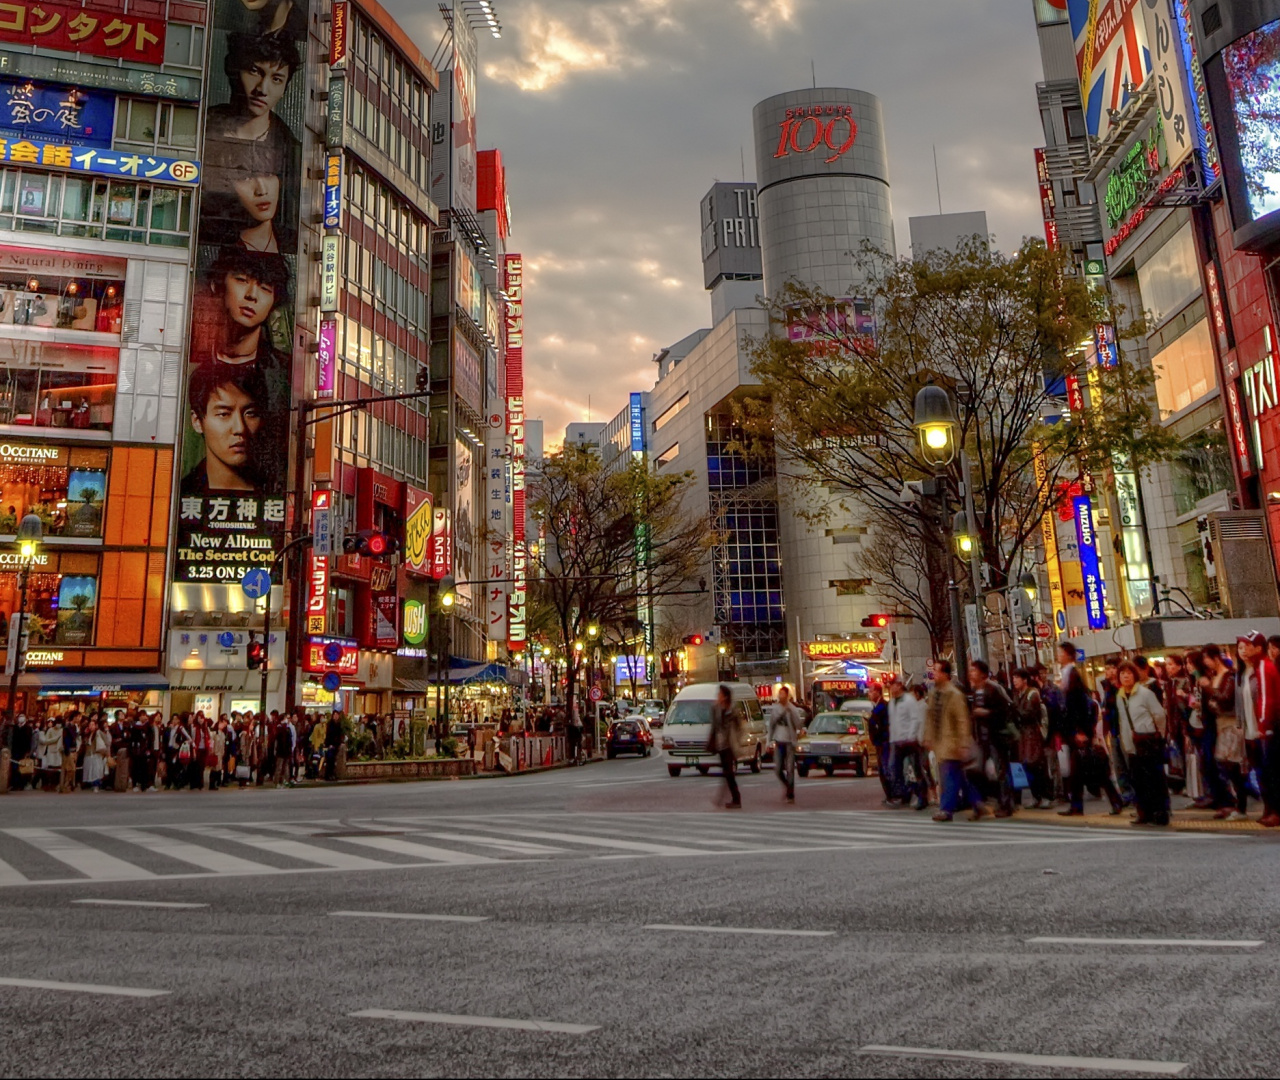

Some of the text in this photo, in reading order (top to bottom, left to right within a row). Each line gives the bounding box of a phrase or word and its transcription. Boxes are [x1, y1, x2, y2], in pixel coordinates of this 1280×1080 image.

[80, 71, 108, 79] JAPANESE
[786, 105, 853, 118] SHIBUYA
[0, 130, 27, 139] MODERN
[773, 115, 858, 163] 109
[173, 164, 194, 178] 6F
[734, 189, 759, 217] TH
[723, 218, 761, 247] PRI
[10, 253, 104, 273] Natural Dining
[324, 242, 337, 305] 渋谷駅前ビル
[322, 321, 335, 329] 5F
[180, 497, 285, 522] 東方神起
[1078, 504, 1091, 545] MIZUHO
[190, 533, 272, 548] New Album
[489, 448, 503, 624] 洋装生地 マルナン
[178, 548, 282, 562] The Secret Cod
[188, 566, 213, 578] 3.25
[216, 567, 236, 578] ON
[1086, 575, 1101, 618] みずほ銀行
[311, 618, 322, 632] 薬
[809, 641, 876, 655] SPRING FAIR
